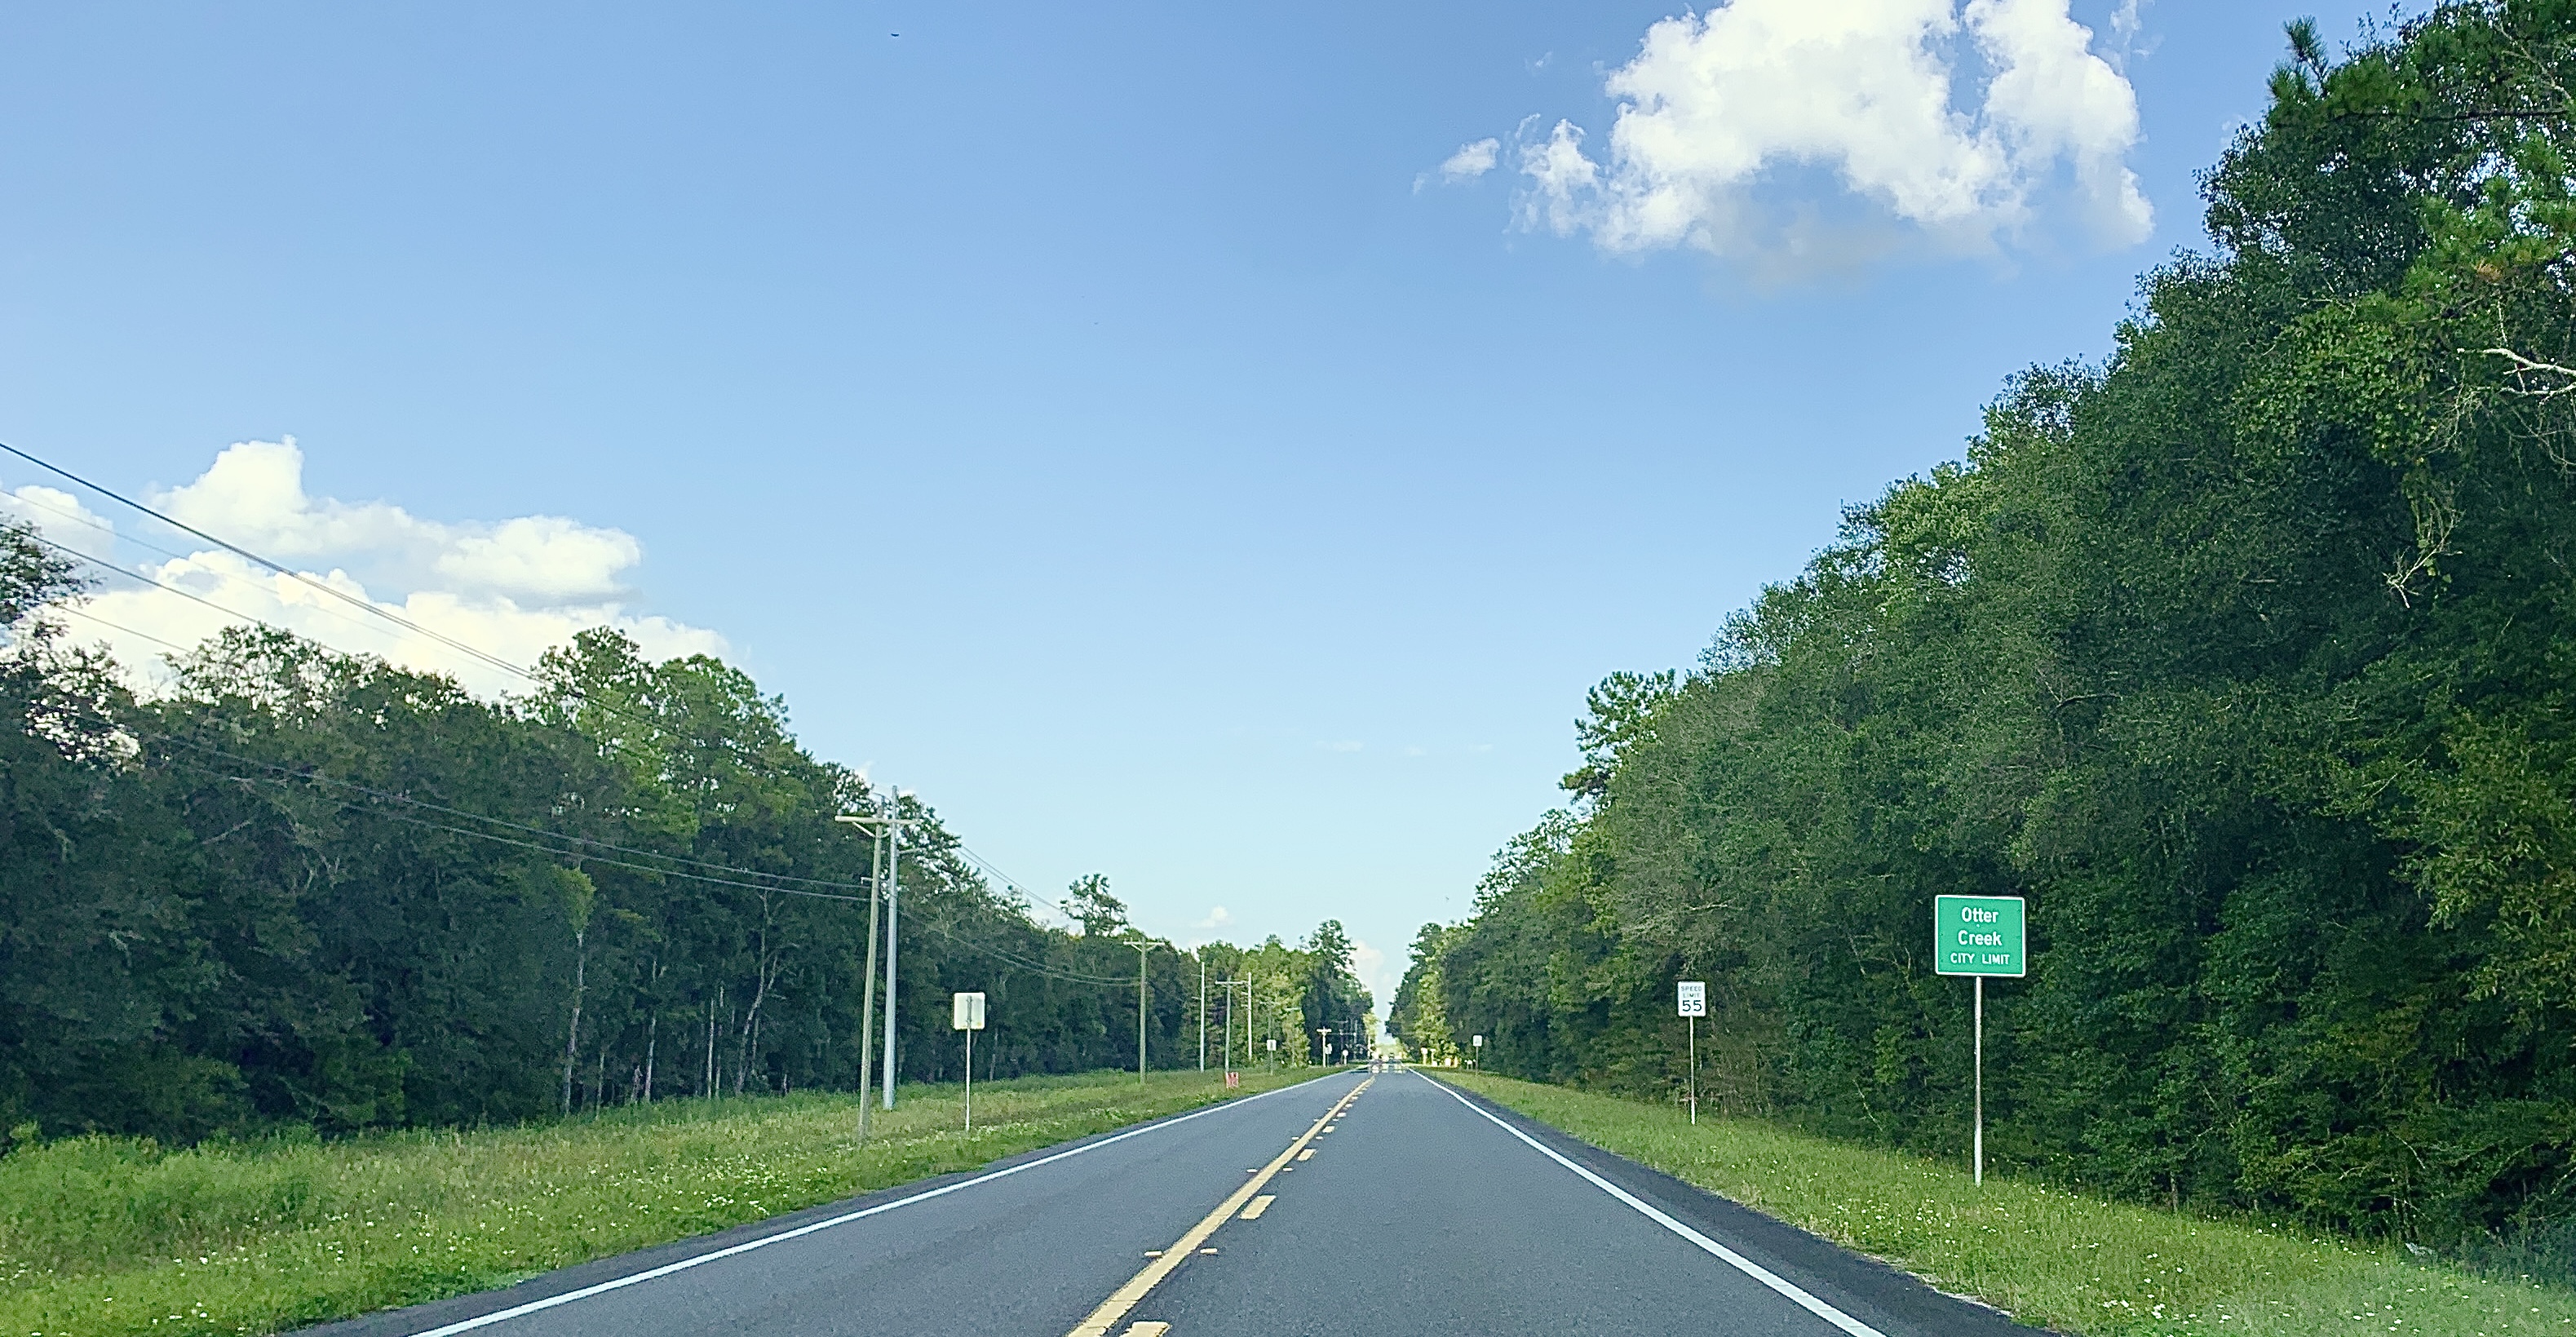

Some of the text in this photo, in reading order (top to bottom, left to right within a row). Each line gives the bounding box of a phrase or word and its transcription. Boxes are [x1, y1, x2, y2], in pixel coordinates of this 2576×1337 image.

[1962, 906, 1998, 923] Otter
[1958, 930, 2002, 945] Creek
[1950, 953, 2010, 964] CITY LIMIT
[1682, 999, 1702, 1012] 55
